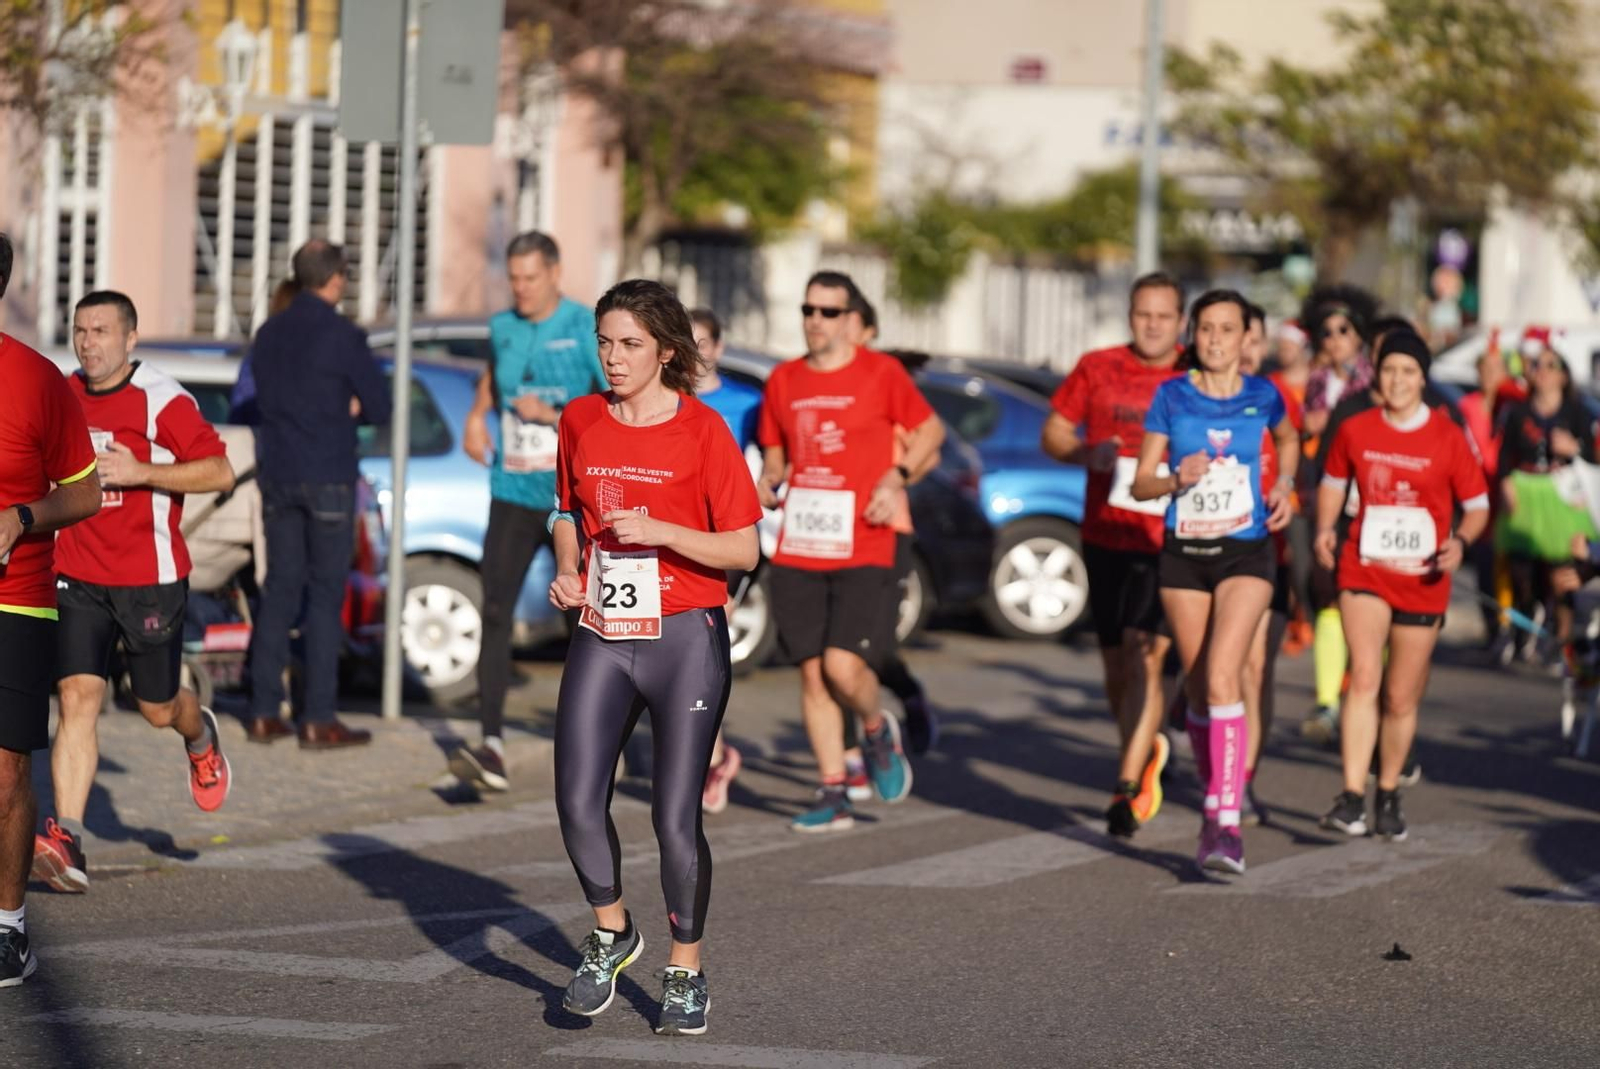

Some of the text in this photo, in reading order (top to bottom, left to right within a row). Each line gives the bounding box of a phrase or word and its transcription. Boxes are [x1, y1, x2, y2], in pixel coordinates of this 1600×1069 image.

[622, 473, 663, 484] CORDOBESA
[637, 467, 674, 477] SILVESTRE
[1193, 491, 1234, 513] 937
[795, 512, 841, 533] 1068
[1380, 530, 1421, 550] 568
[664, 575, 674, 583] DE
